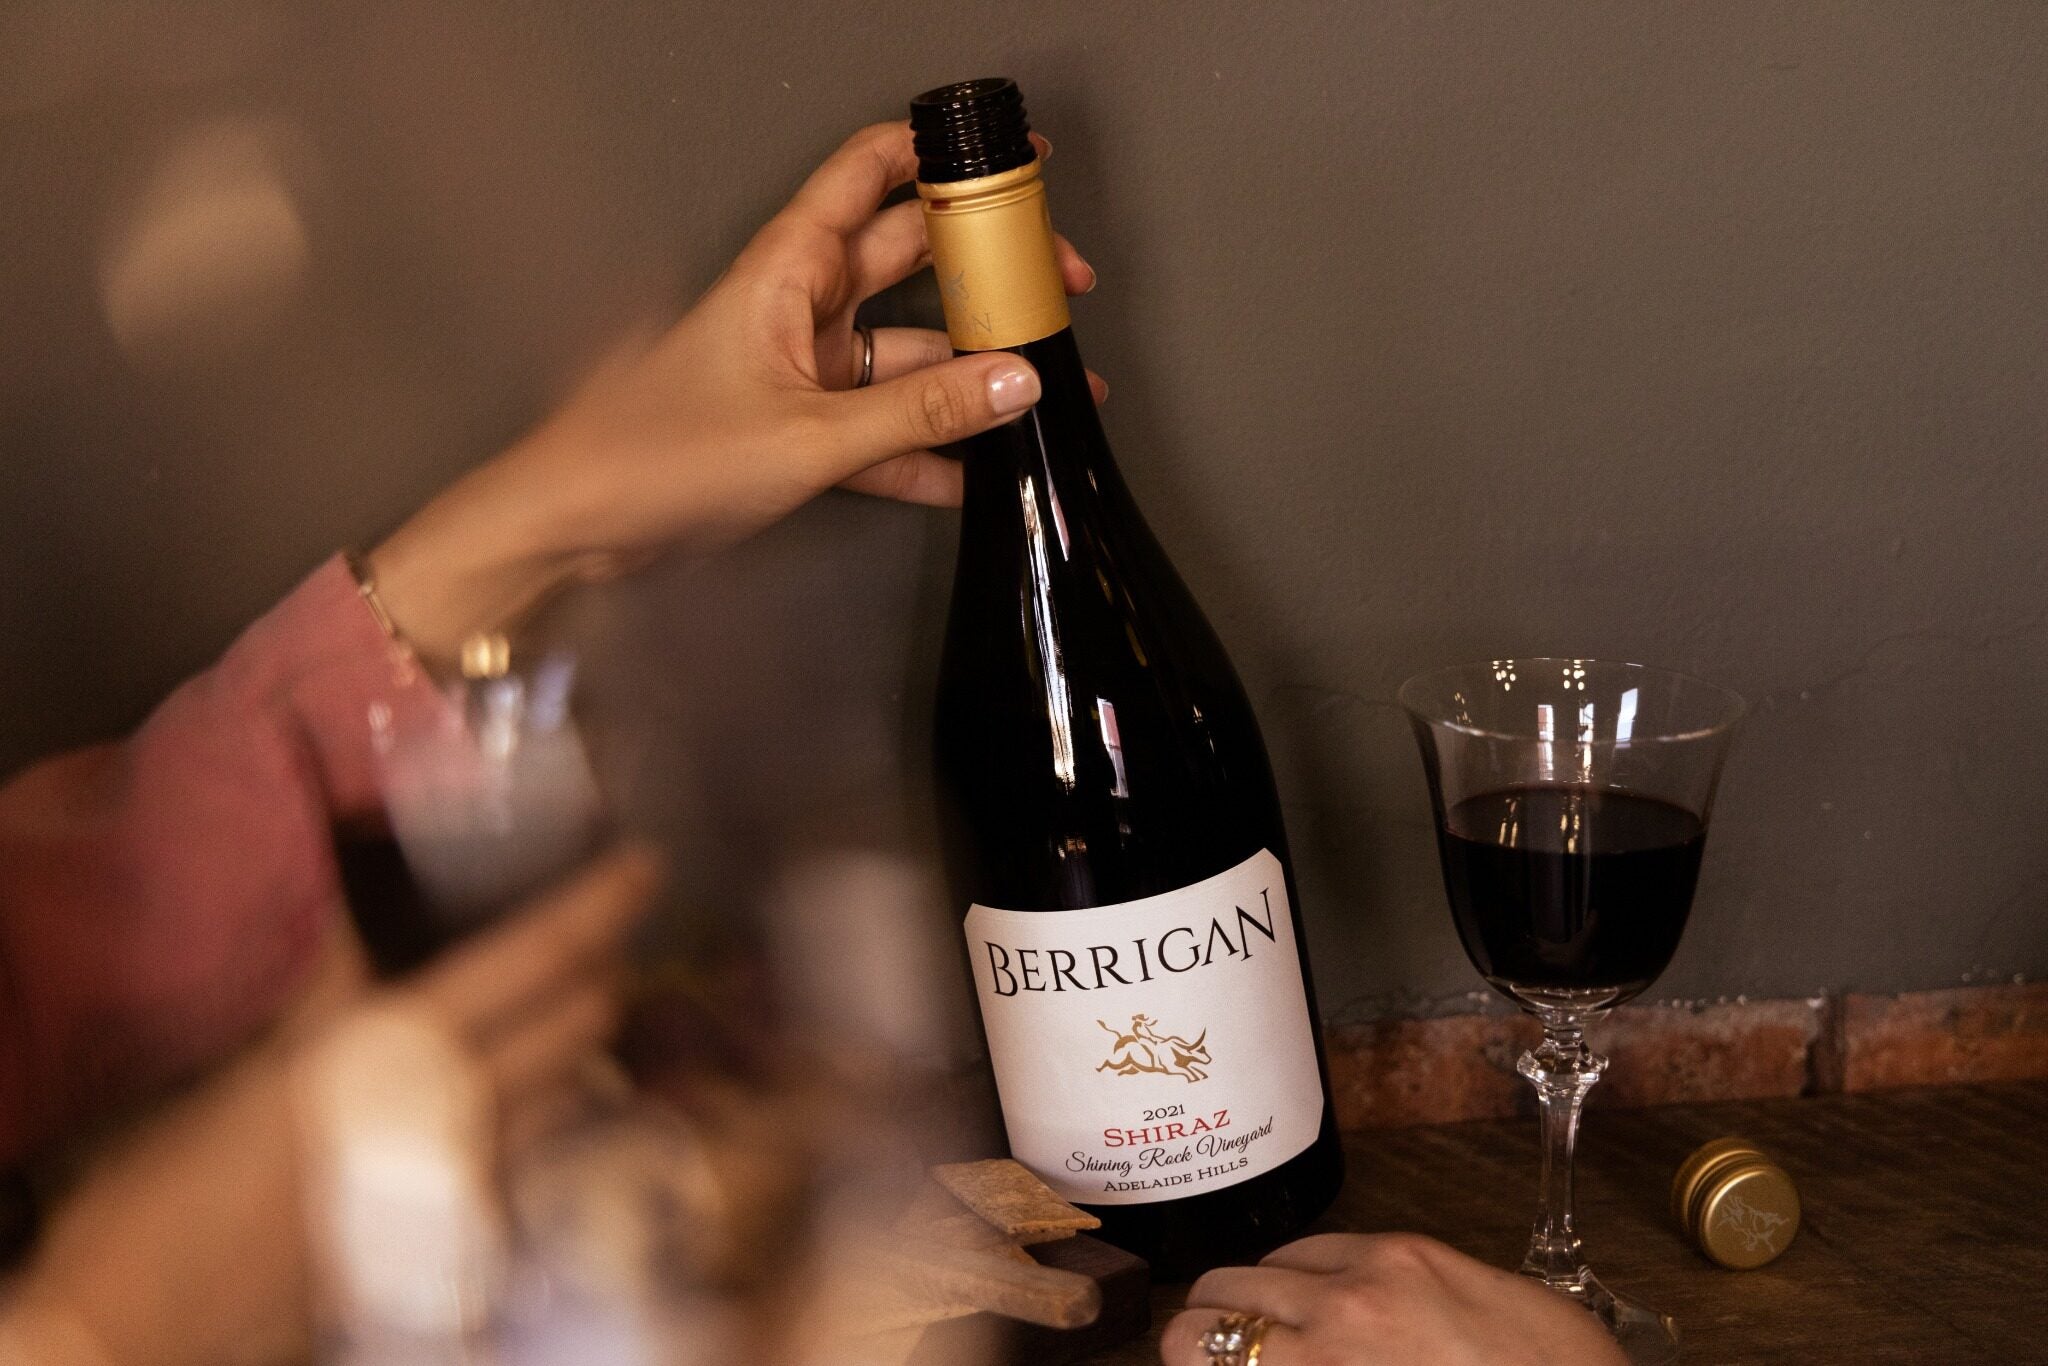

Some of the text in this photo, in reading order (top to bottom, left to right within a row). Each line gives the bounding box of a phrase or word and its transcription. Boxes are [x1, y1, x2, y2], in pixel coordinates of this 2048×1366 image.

[984, 887, 1277, 997] BERRIGAN
[1103, 1109, 1231, 1148] SHIRAZ
[1143, 1103, 1186, 1122] 2021
[1066, 1116, 1273, 1177] Shining Rock Vineyard
[1103, 1156, 1249, 1192] ADELAIDE HILLS
